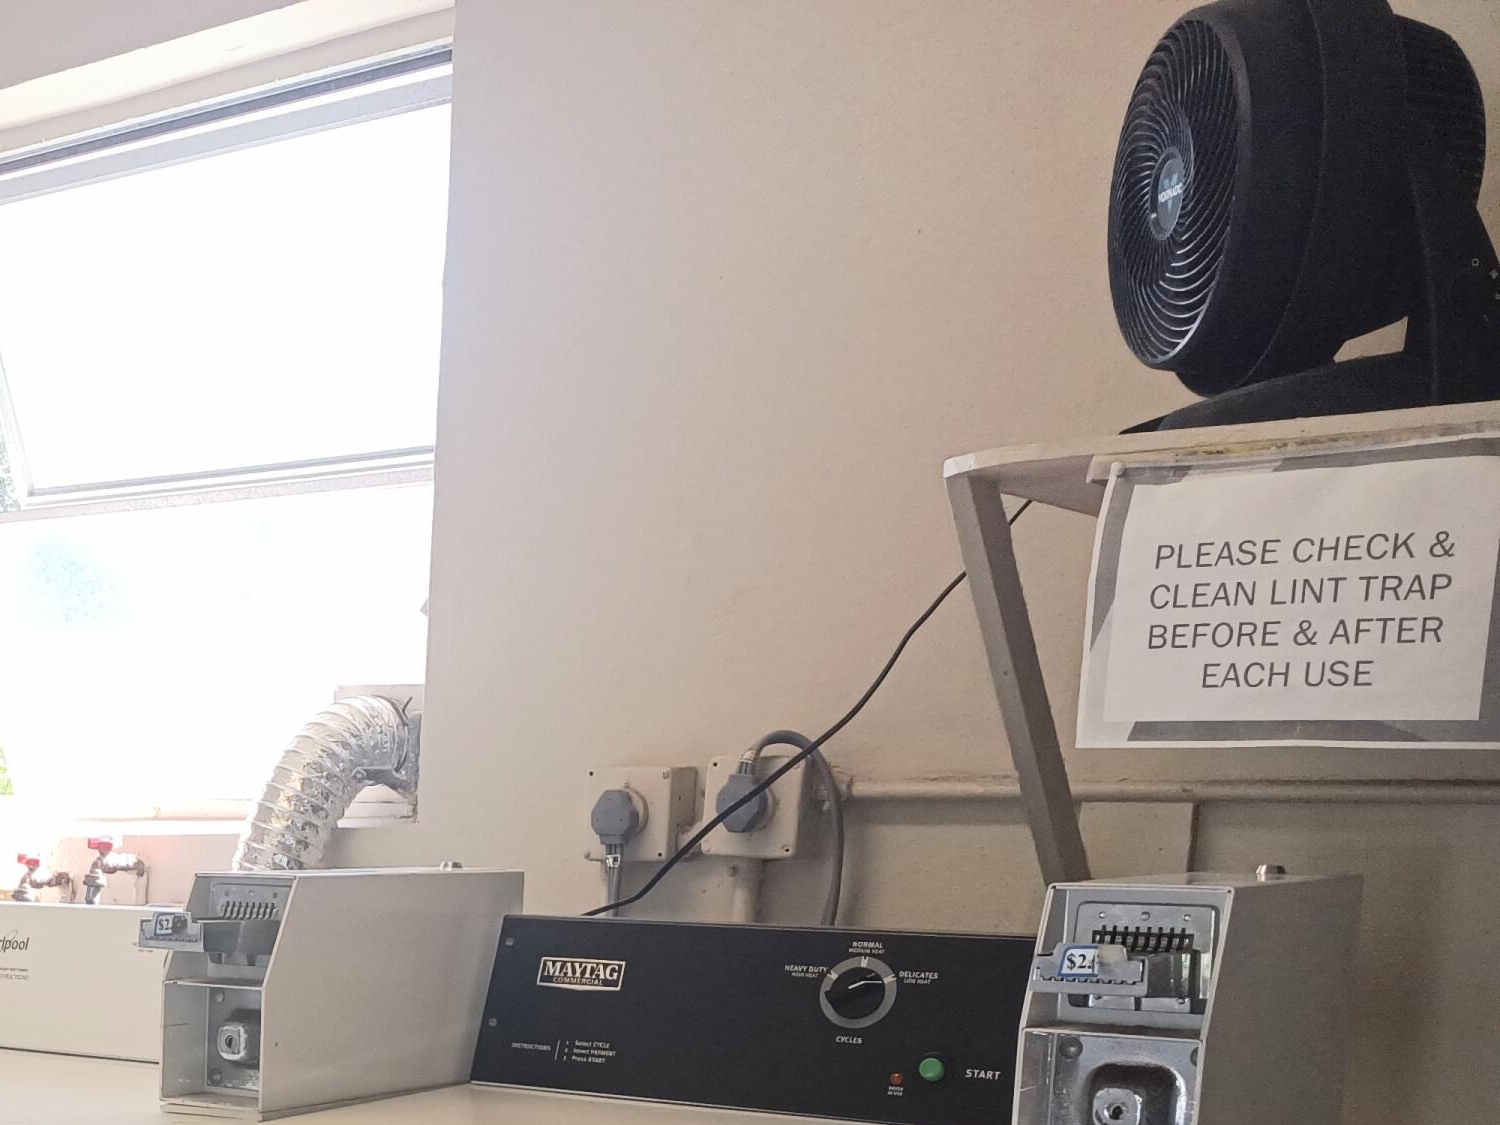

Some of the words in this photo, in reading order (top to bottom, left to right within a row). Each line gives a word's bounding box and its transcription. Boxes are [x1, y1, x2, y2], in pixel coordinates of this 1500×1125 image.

[1154, 539, 1281, 569] PLEASE
[1292, 532, 1416, 564] CHECK
[1428, 530, 1456, 558] &
[1149, 580, 1257, 609] CLEAN
[1269, 576, 1347, 605] LINT
[1358, 573, 1453, 602] TRAP
[1147, 620, 1281, 649] BEFORE
[1292, 619, 1318, 647] &
[1329, 616, 1444, 645] AFTER
[1201, 661, 1290, 688] EACH
[1304, 660, 1374, 687] USE
[852, 941, 883, 949] NORMAL
[785, 964, 807, 972] HEAVY
[808, 965, 828, 973] DUTY
[1067, 952, 1094, 972] $2.
[543, 960, 619, 980] MAYTAG
[899, 970, 939, 980] DELICATES
[552, 976, 604, 986] COMMERCIAL
[835, 1035, 863, 1044] CYCLES
[965, 1069, 1001, 1080] START
